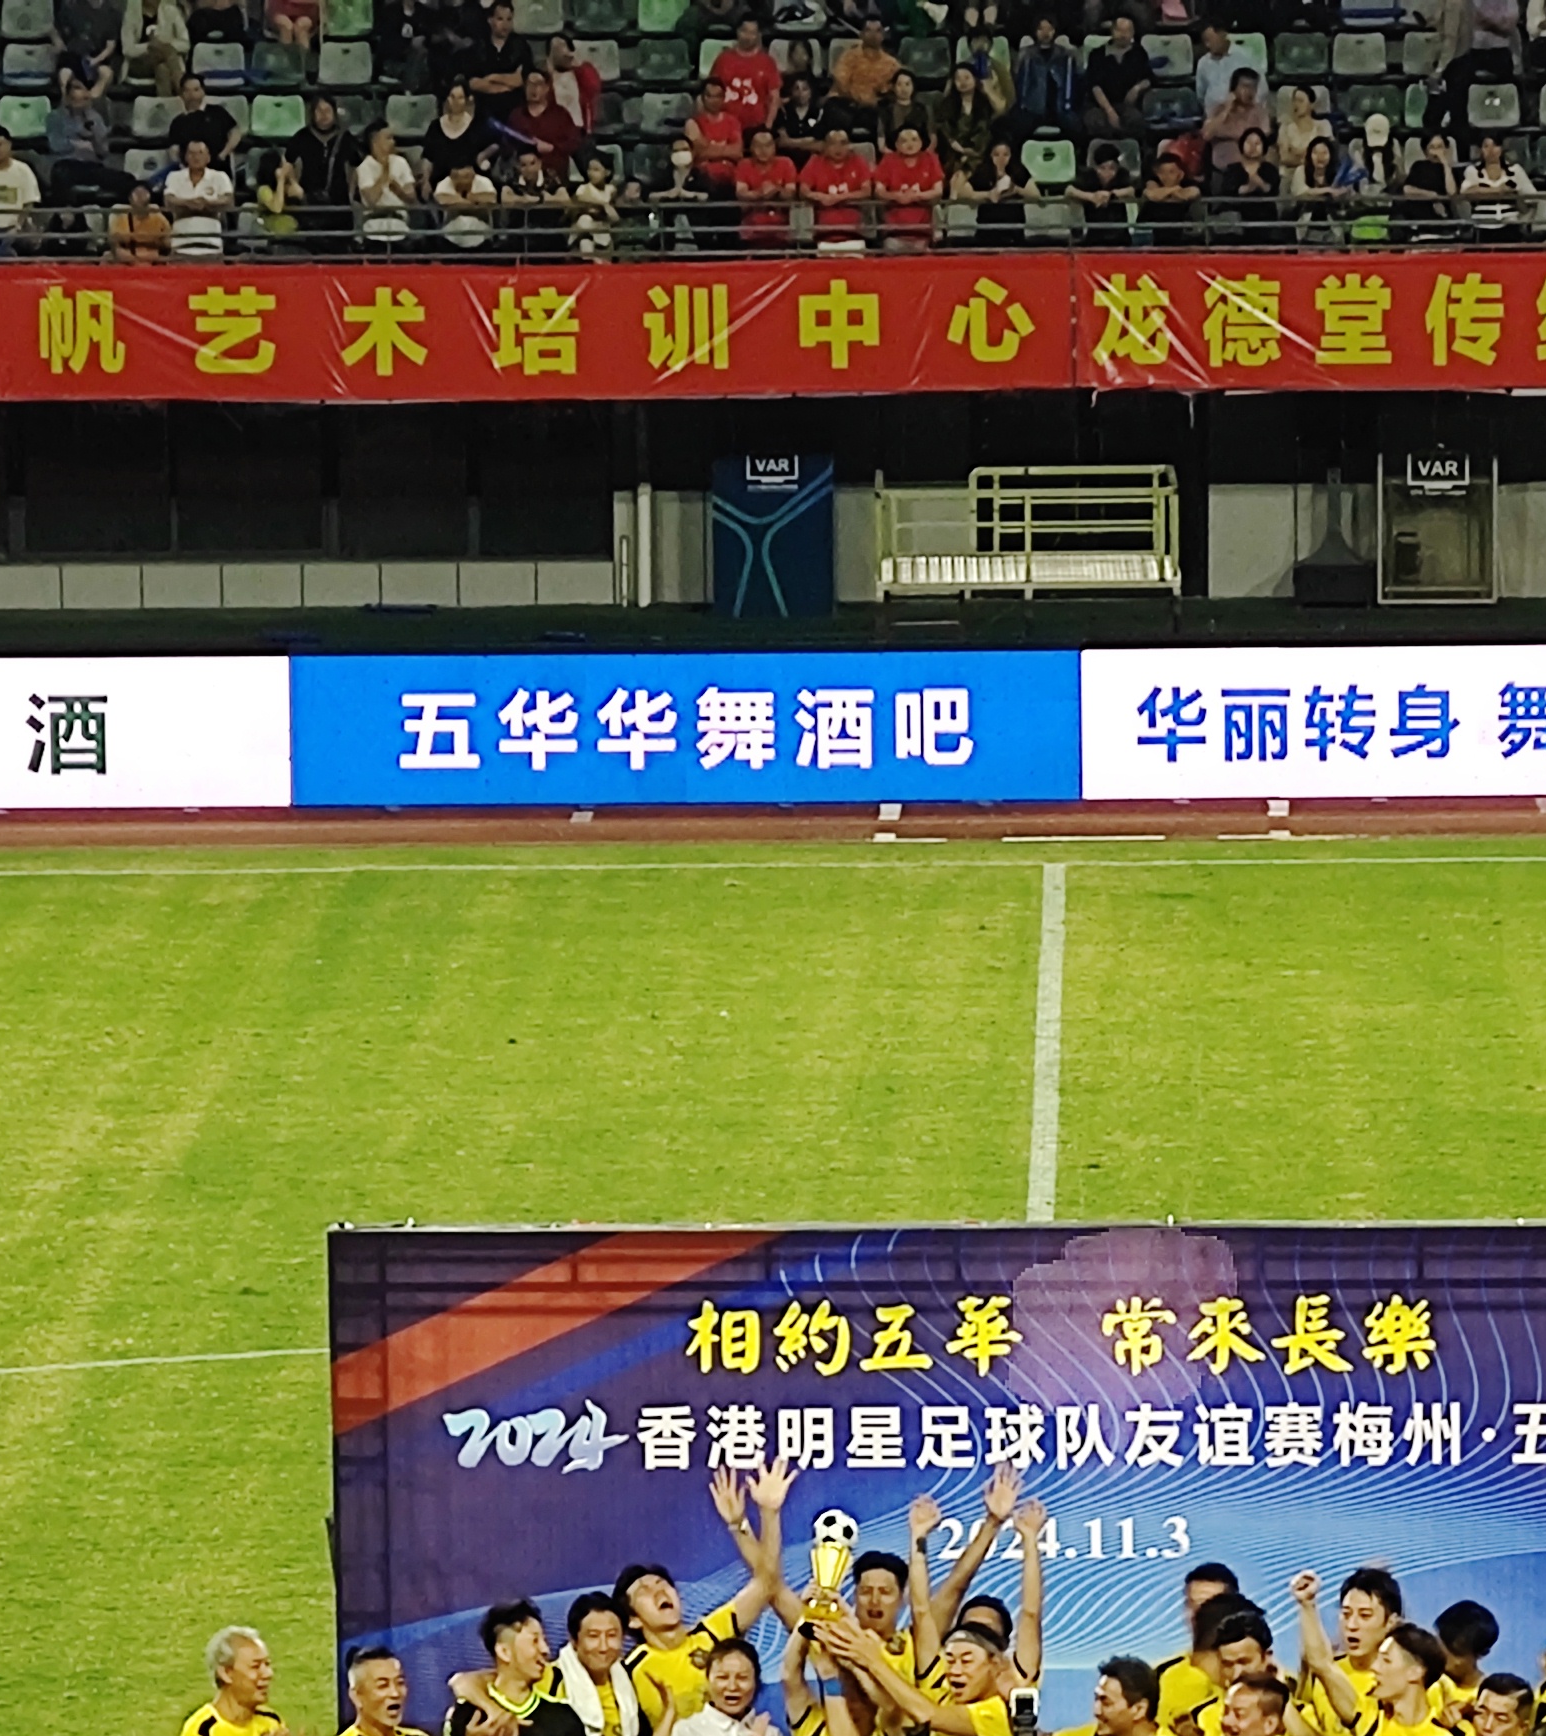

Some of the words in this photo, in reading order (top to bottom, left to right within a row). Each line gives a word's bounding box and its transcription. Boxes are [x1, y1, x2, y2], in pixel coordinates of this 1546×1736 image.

[755, 458, 789, 472] VAR
[1418, 460, 1458, 476] VAR
[398, 687, 975, 772] 五华华舞酒吧
[1136, 684, 1460, 763] 华丽转身
[685, 1296, 1023, 1377] 相約五華
[444, 1399, 629, 1475] 2024
